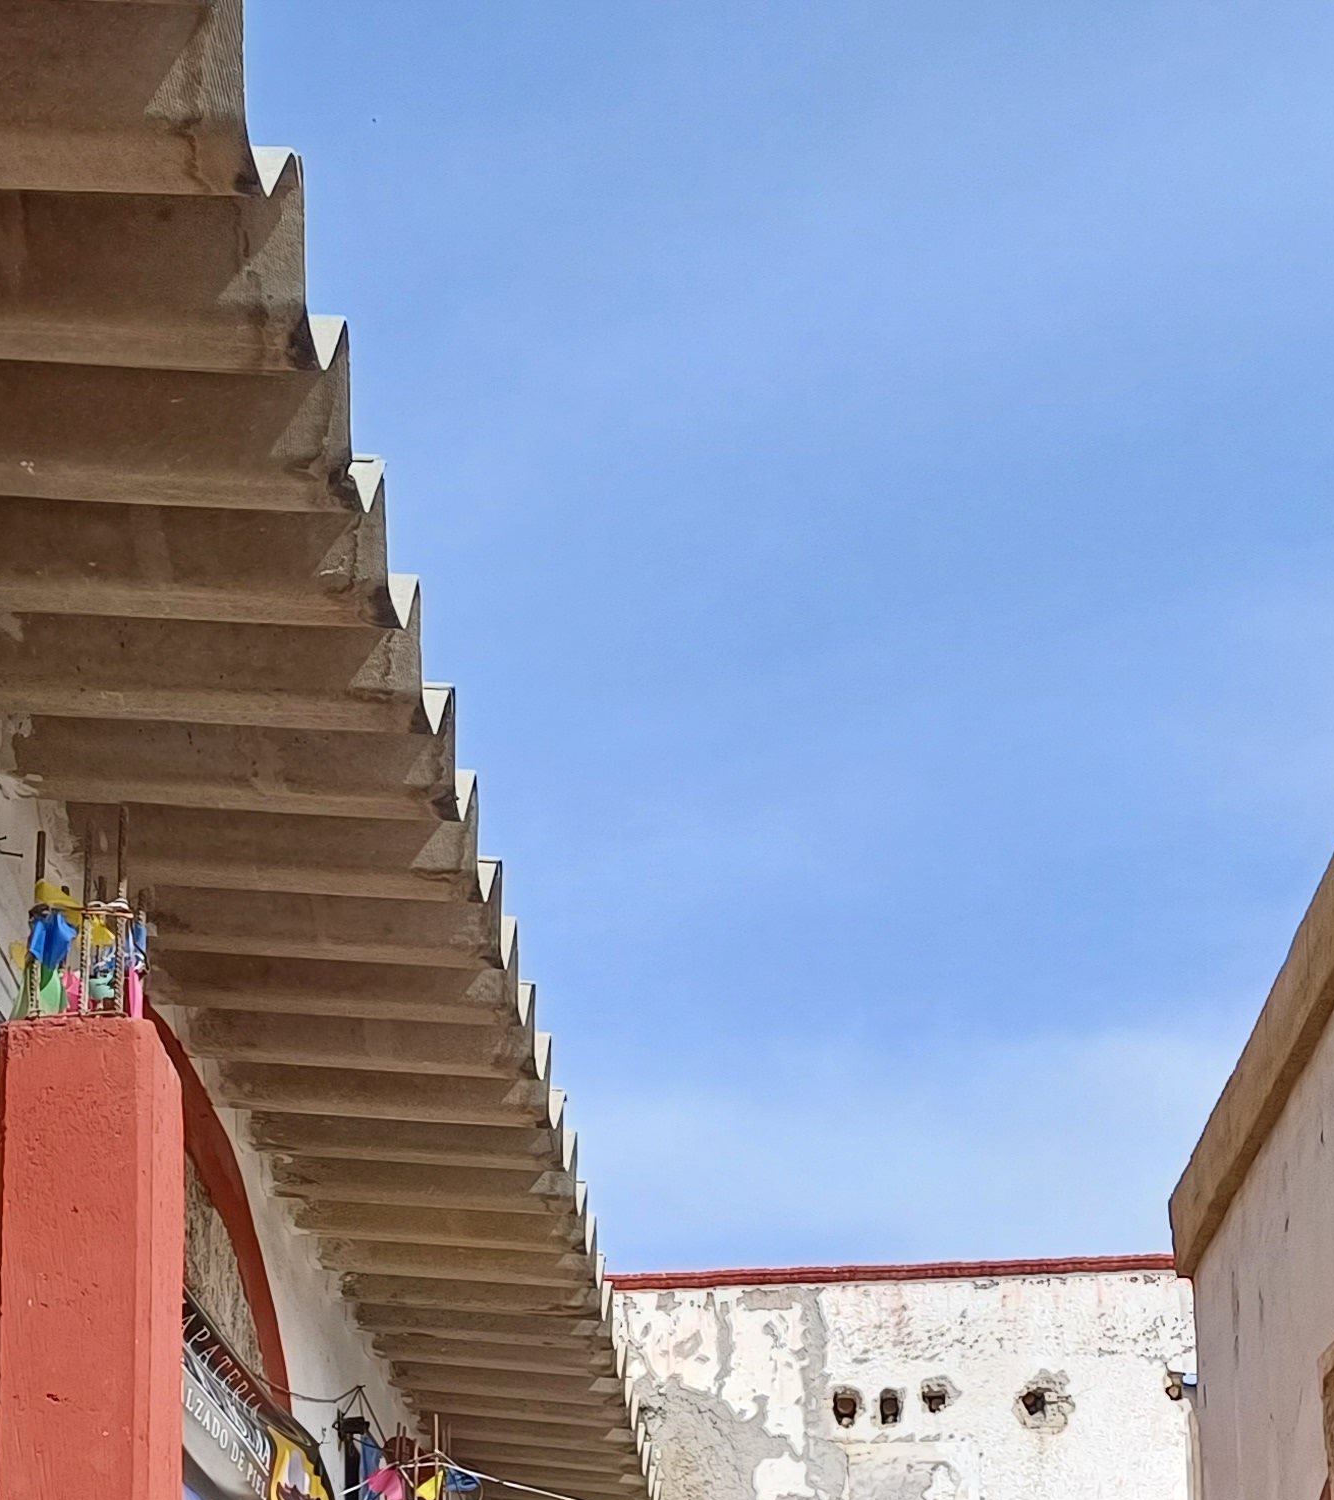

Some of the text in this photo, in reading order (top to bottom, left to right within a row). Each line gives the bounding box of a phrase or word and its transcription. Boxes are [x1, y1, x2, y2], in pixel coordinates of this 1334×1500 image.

[182, 1387, 267, 1500] LZADO DE PIEL
